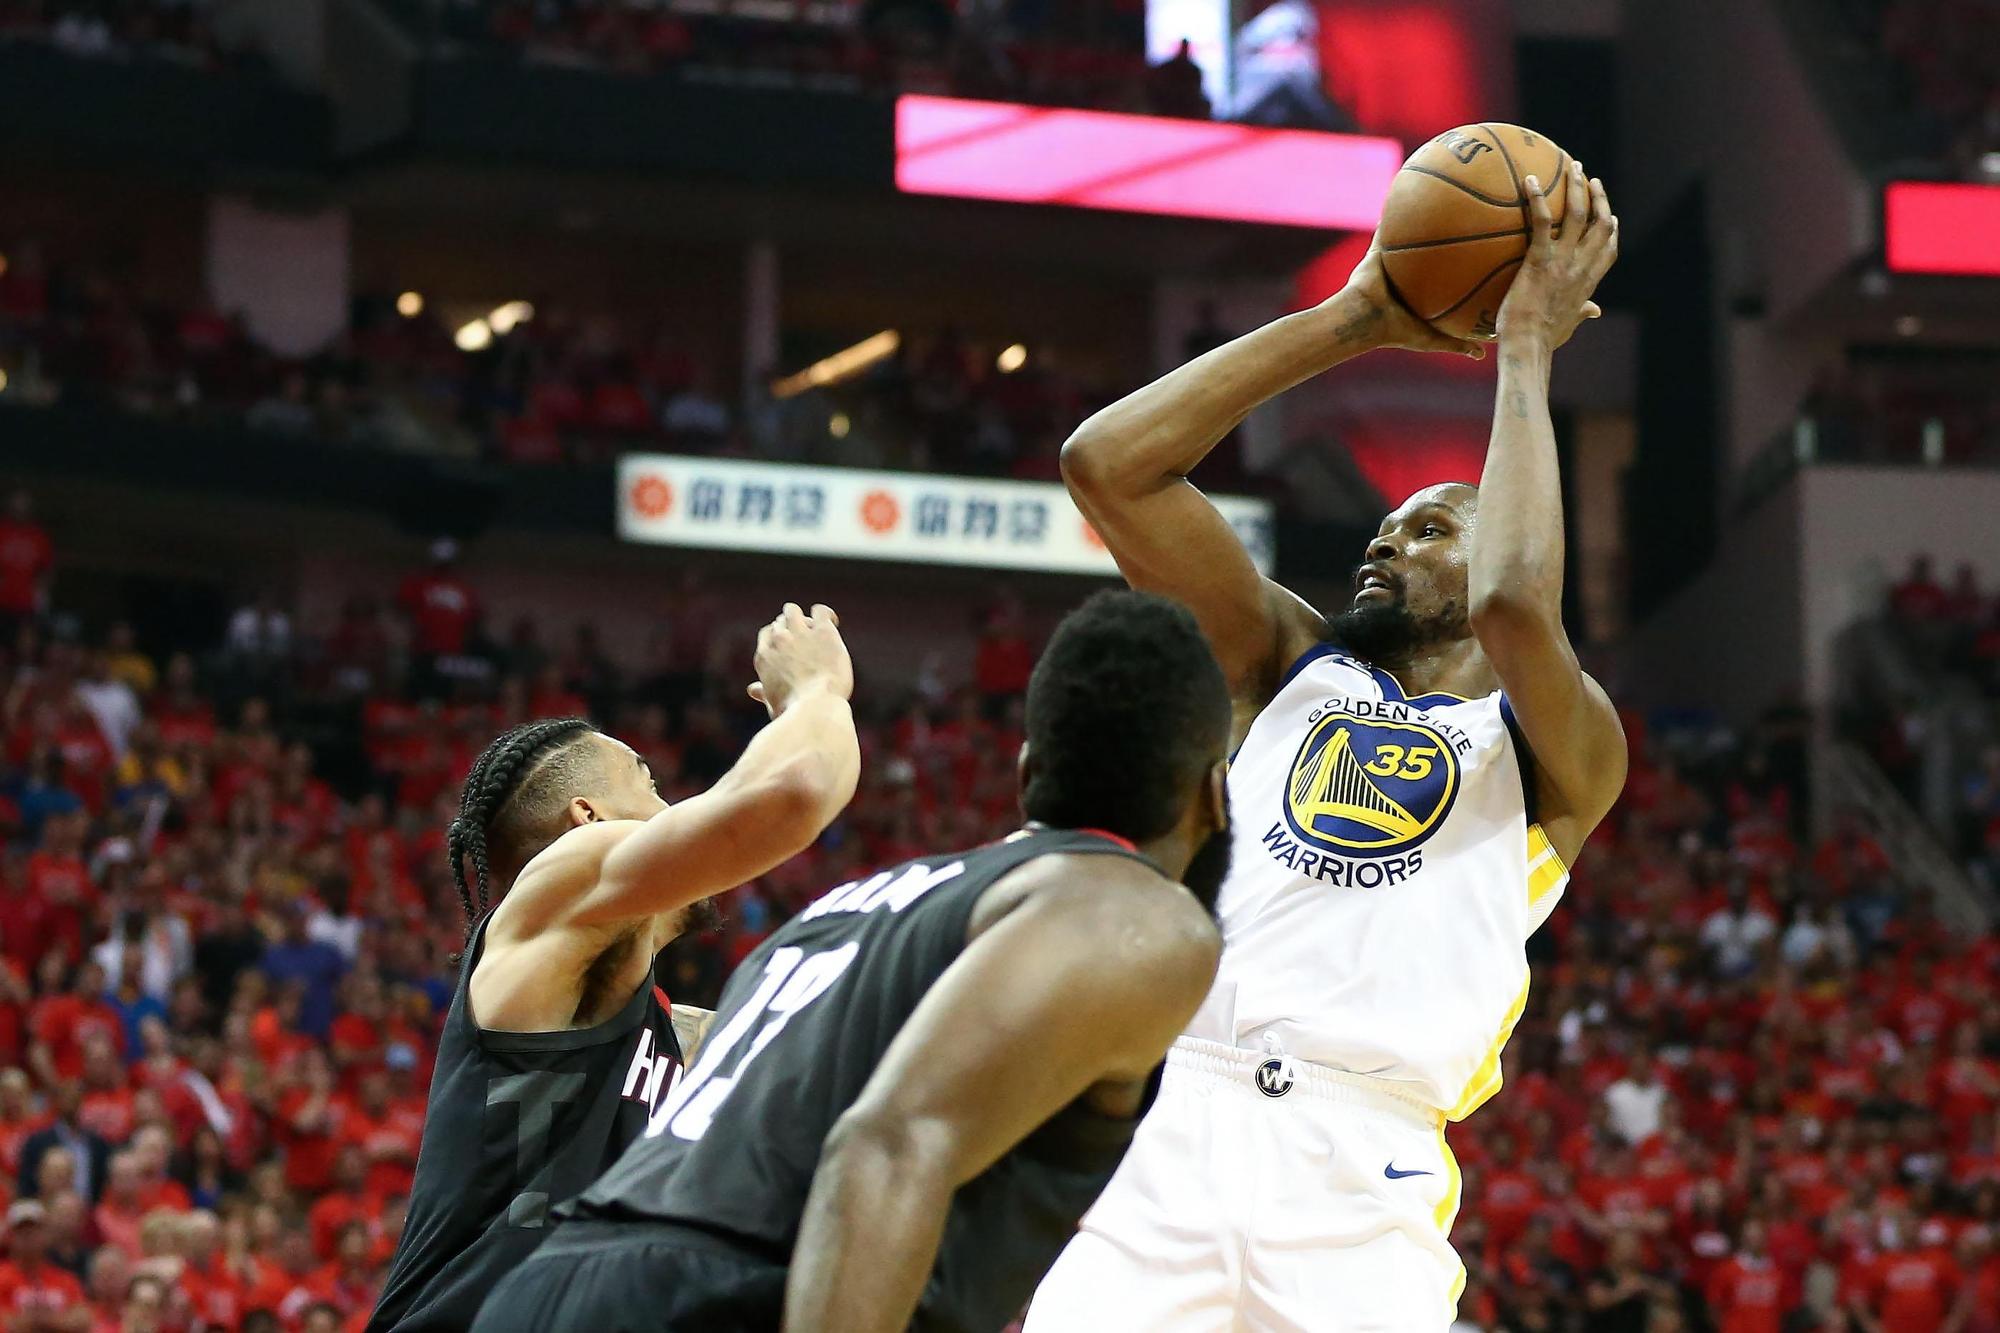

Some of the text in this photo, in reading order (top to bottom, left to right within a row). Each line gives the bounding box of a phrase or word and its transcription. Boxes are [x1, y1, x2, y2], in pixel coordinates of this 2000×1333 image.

[1308, 697, 1408, 723] GOLDEN
[1363, 743, 1440, 781] 35
[1262, 821, 1422, 888] WARRIORS
